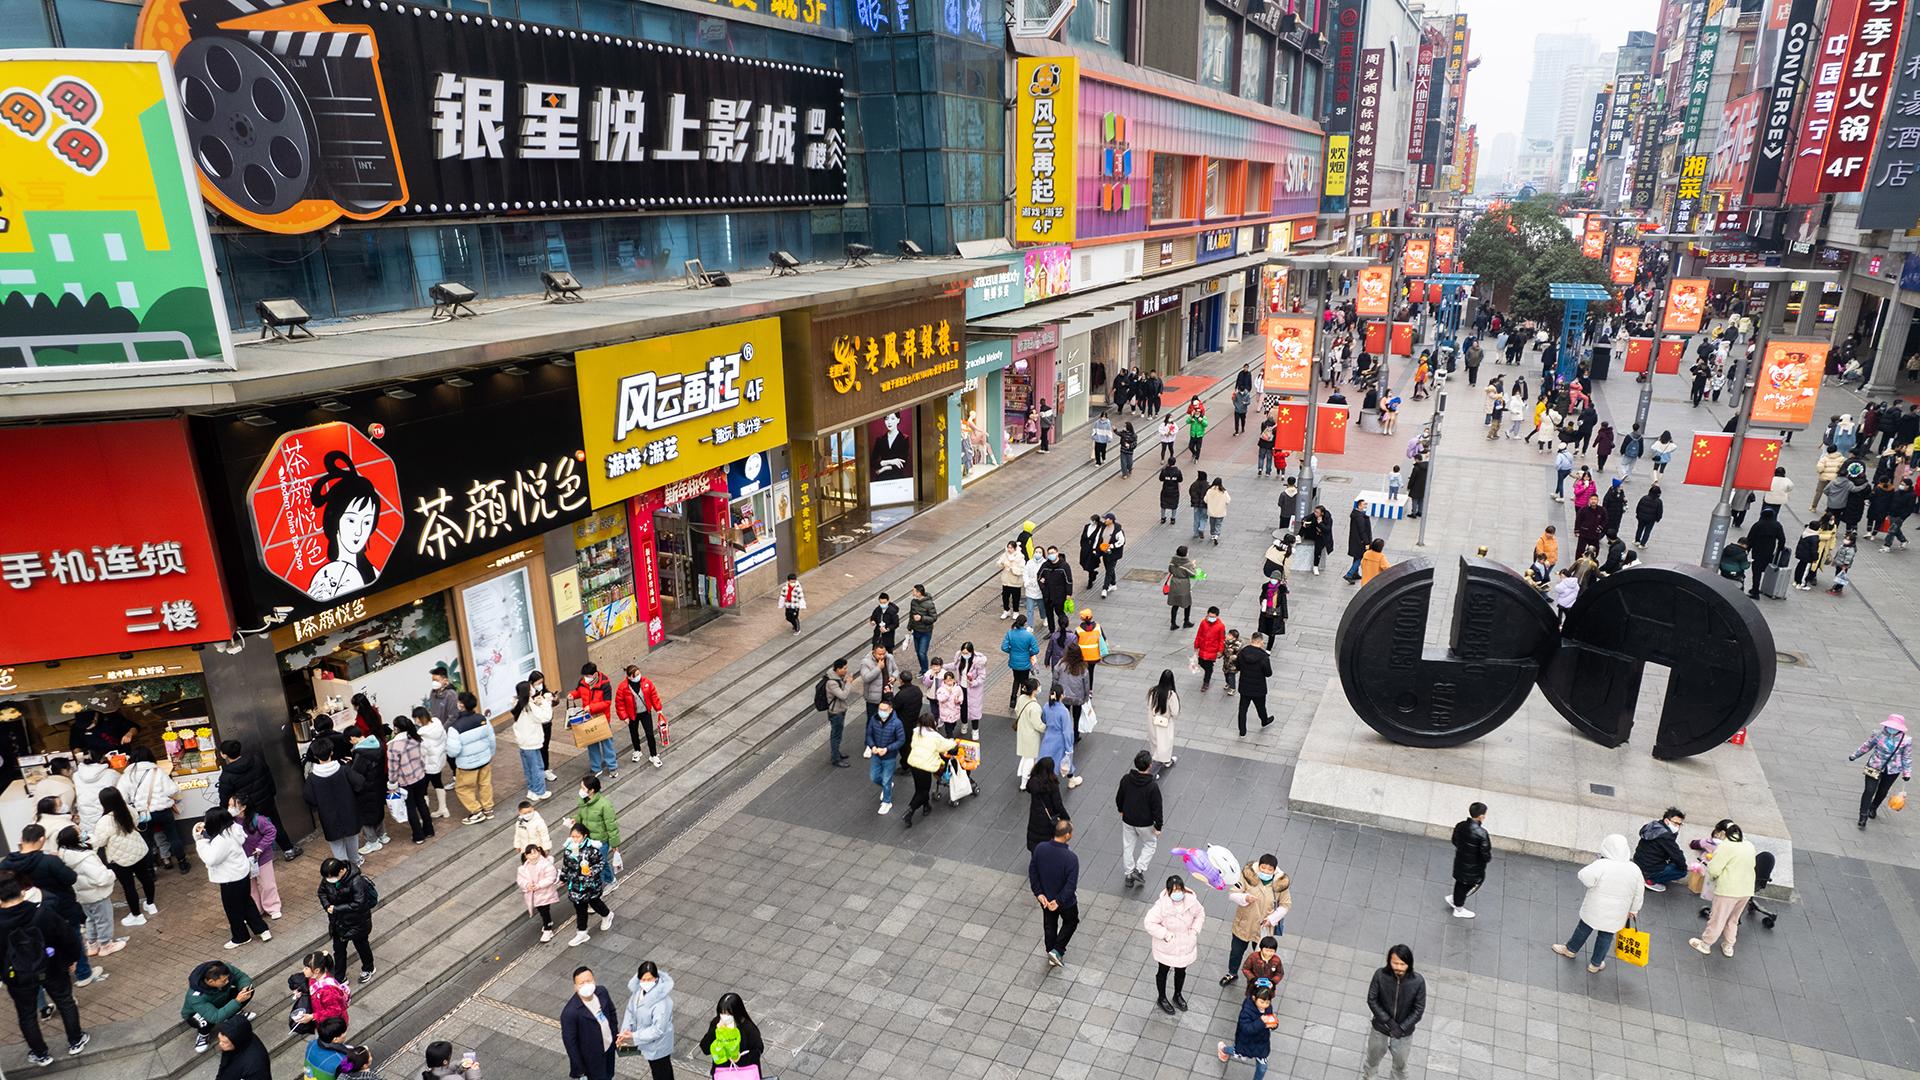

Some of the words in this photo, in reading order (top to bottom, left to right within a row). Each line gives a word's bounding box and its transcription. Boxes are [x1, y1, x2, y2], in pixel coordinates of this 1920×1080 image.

[1768, 22, 1807, 140] CONVERSE
[433, 73, 798, 164] 银星悦上影城
[1336, 107, 1347, 115] 3F
[1594, 103, 1605, 122] CRD
[1609, 81, 1634, 141] 直通车眼镜
[804, 108, 828, 170] 四楼
[1032, 98, 1056, 203] 风云再起
[358, 161, 376, 170] INT.
[1677, 156, 1707, 200] 湘菜
[1826, 157, 1863, 177] 4F
[1354, 187, 1369, 196] 3F
[1032, 219, 1052, 233] 4F
[614, 353, 743, 442] 风云再起
[745, 377, 764, 402] 4F
[278, 475, 291, 511] Modern
[285, 510, 297, 535] China
[291, 535, 301, 552] Tea
[0, 540, 187, 589] 手机连锁
[294, 549, 305, 571] Shop
[125, 600, 200, 633] 二楼
